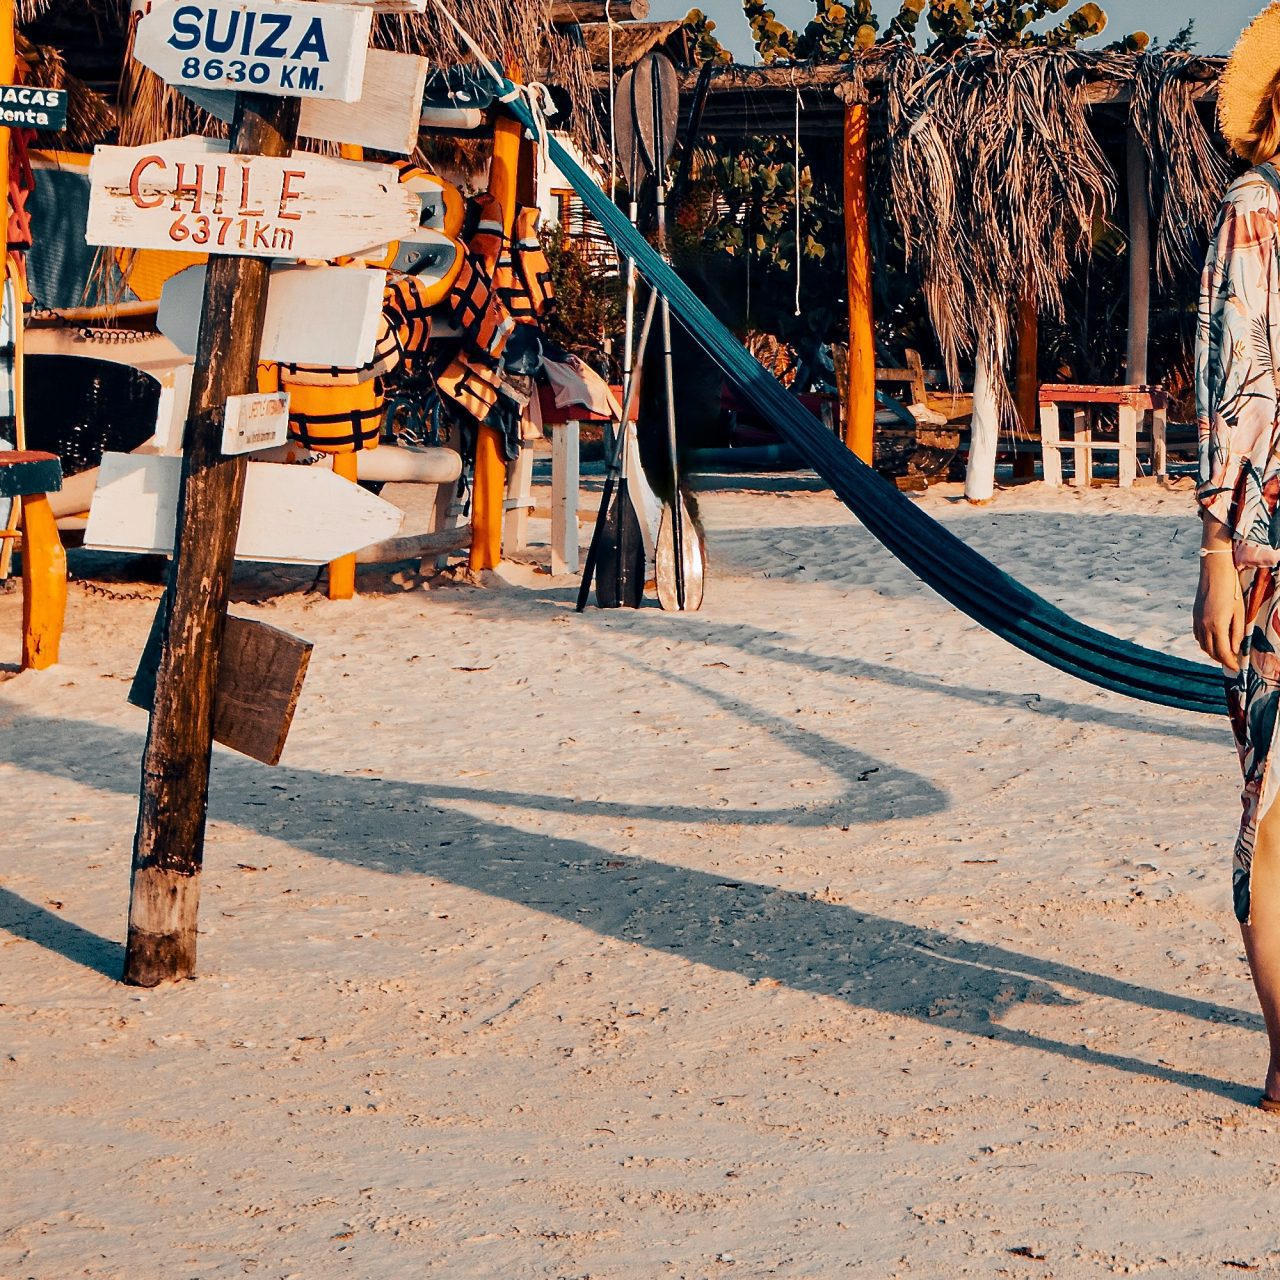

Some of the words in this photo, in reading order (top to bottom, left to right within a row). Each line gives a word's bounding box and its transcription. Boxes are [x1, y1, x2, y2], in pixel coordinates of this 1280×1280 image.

[167, 5, 330, 62] SUIZA
[181, 57, 270, 84] 8630
[280, 65, 324, 91] KM.
[0, 87, 59, 107] ACAS
[128, 155, 305, 220] CHILE
